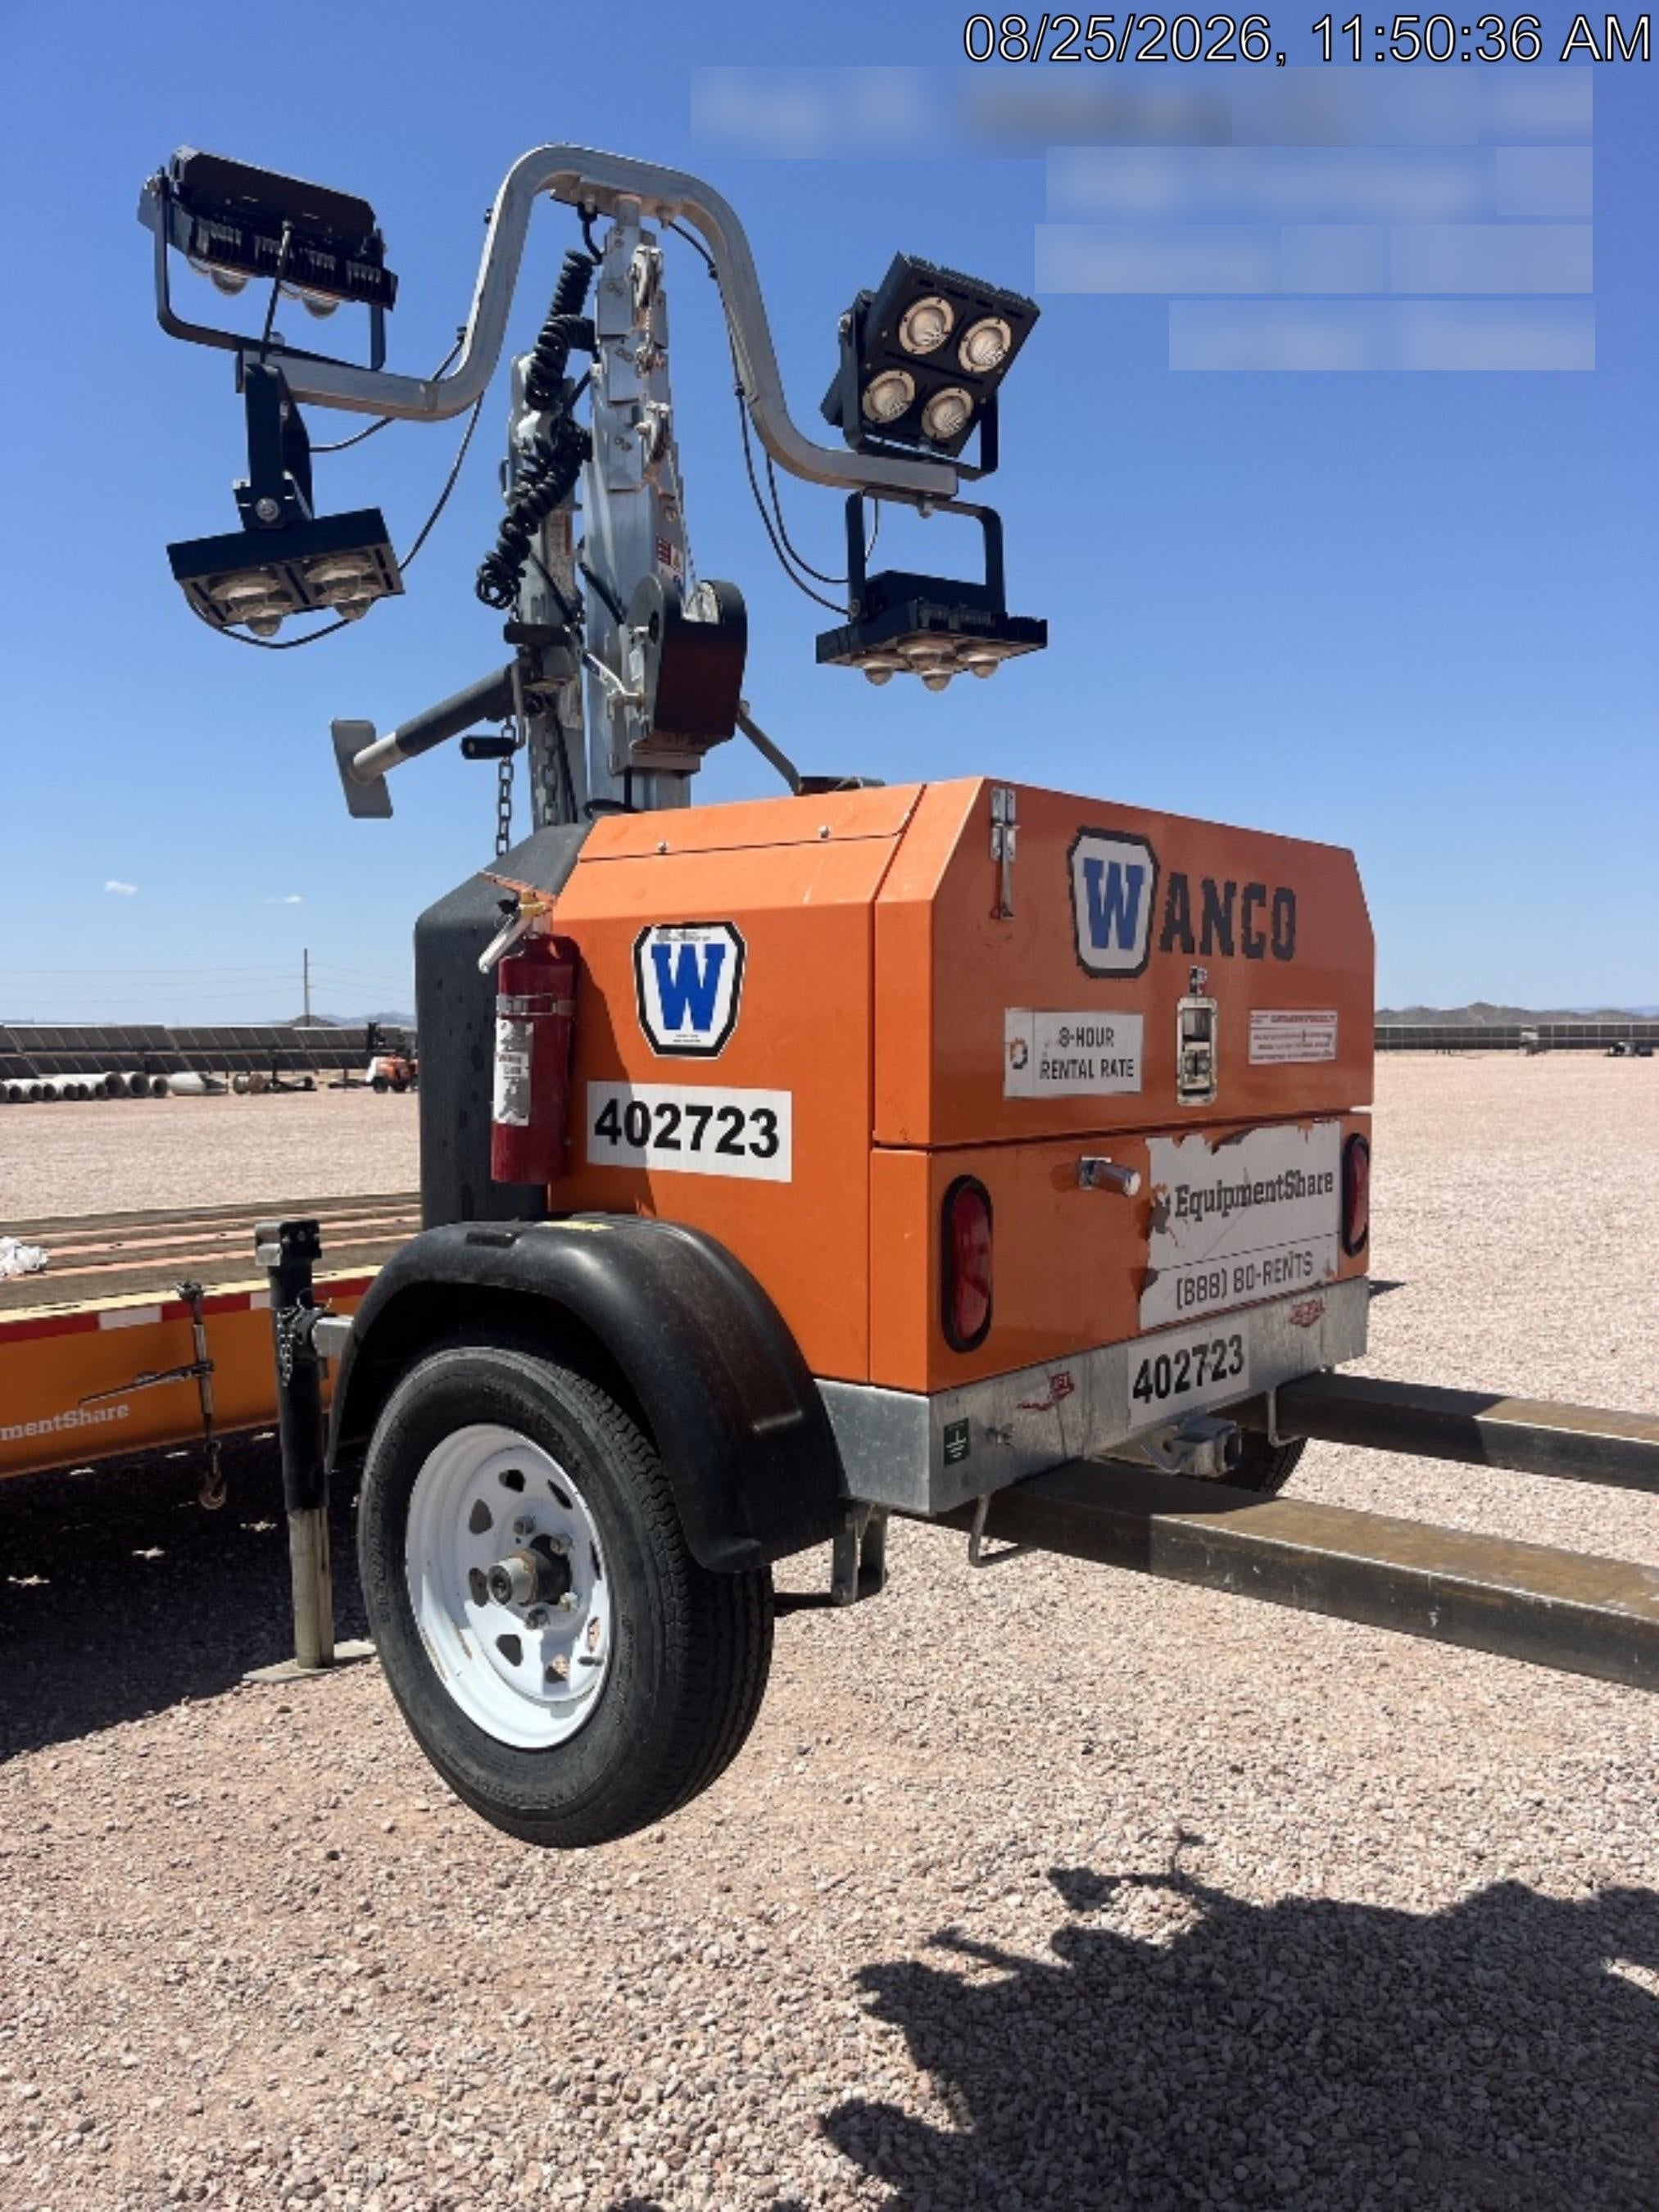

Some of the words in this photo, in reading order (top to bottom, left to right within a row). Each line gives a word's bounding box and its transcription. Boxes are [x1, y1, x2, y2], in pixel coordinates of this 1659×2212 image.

[1083, 857, 1296, 962] WANCO
[650, 943, 726, 1032] W
[1058, 1026, 1115, 1049] 8-HOUR
[1040, 1058, 1095, 1080] RENTAL
[1100, 1058, 1135, 1078] RATE
[594, 1099, 780, 1158] 402723
[1174, 1169, 1334, 1222] EquipmentShare
[1132, 1334, 1244, 1404] 402723
[0, 1402, 129, 1442] mentShare
